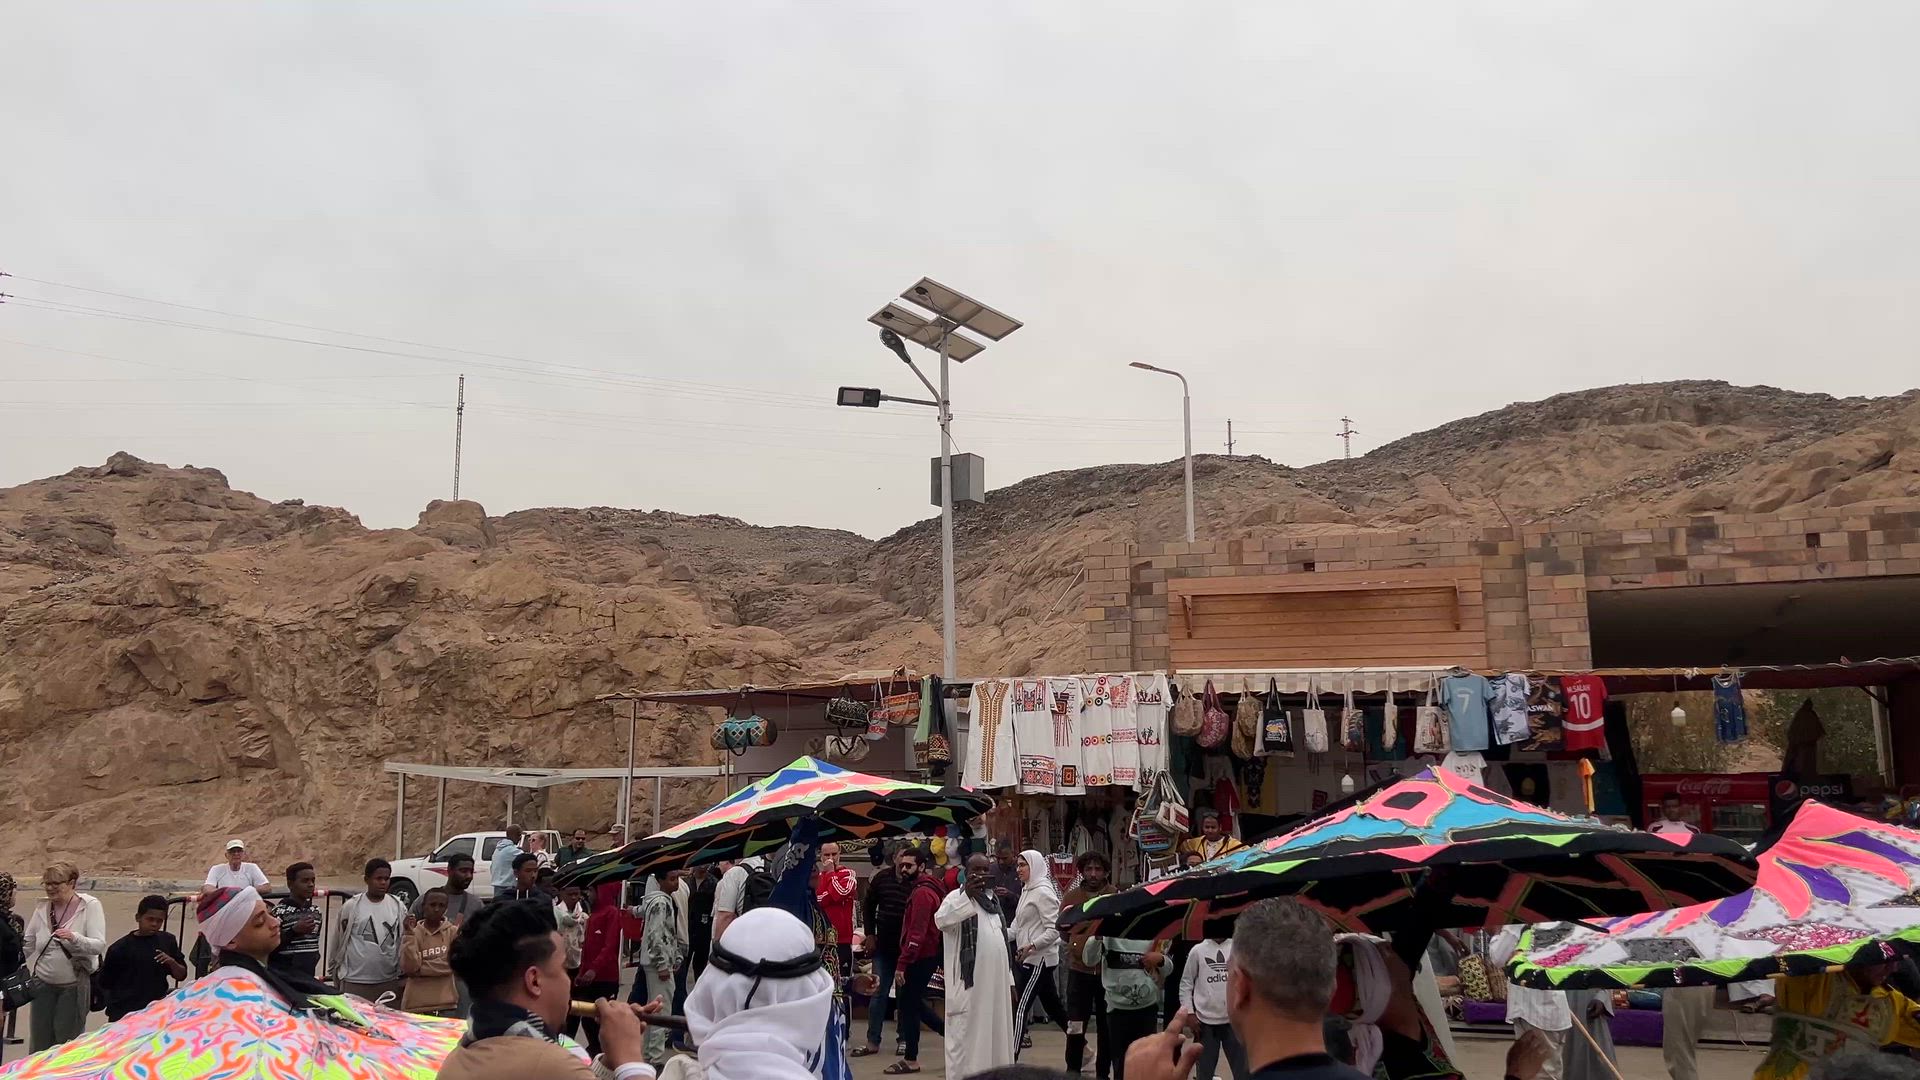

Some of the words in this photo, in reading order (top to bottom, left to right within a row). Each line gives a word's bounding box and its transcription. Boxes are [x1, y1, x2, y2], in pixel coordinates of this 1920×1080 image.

[1457, 694, 1470, 714] 7
[1570, 692, 1591, 719] 10
[1800, 784, 1843, 797] pepsi
[419, 945, 447, 958] EADY
[1207, 973, 1228, 984] adid
